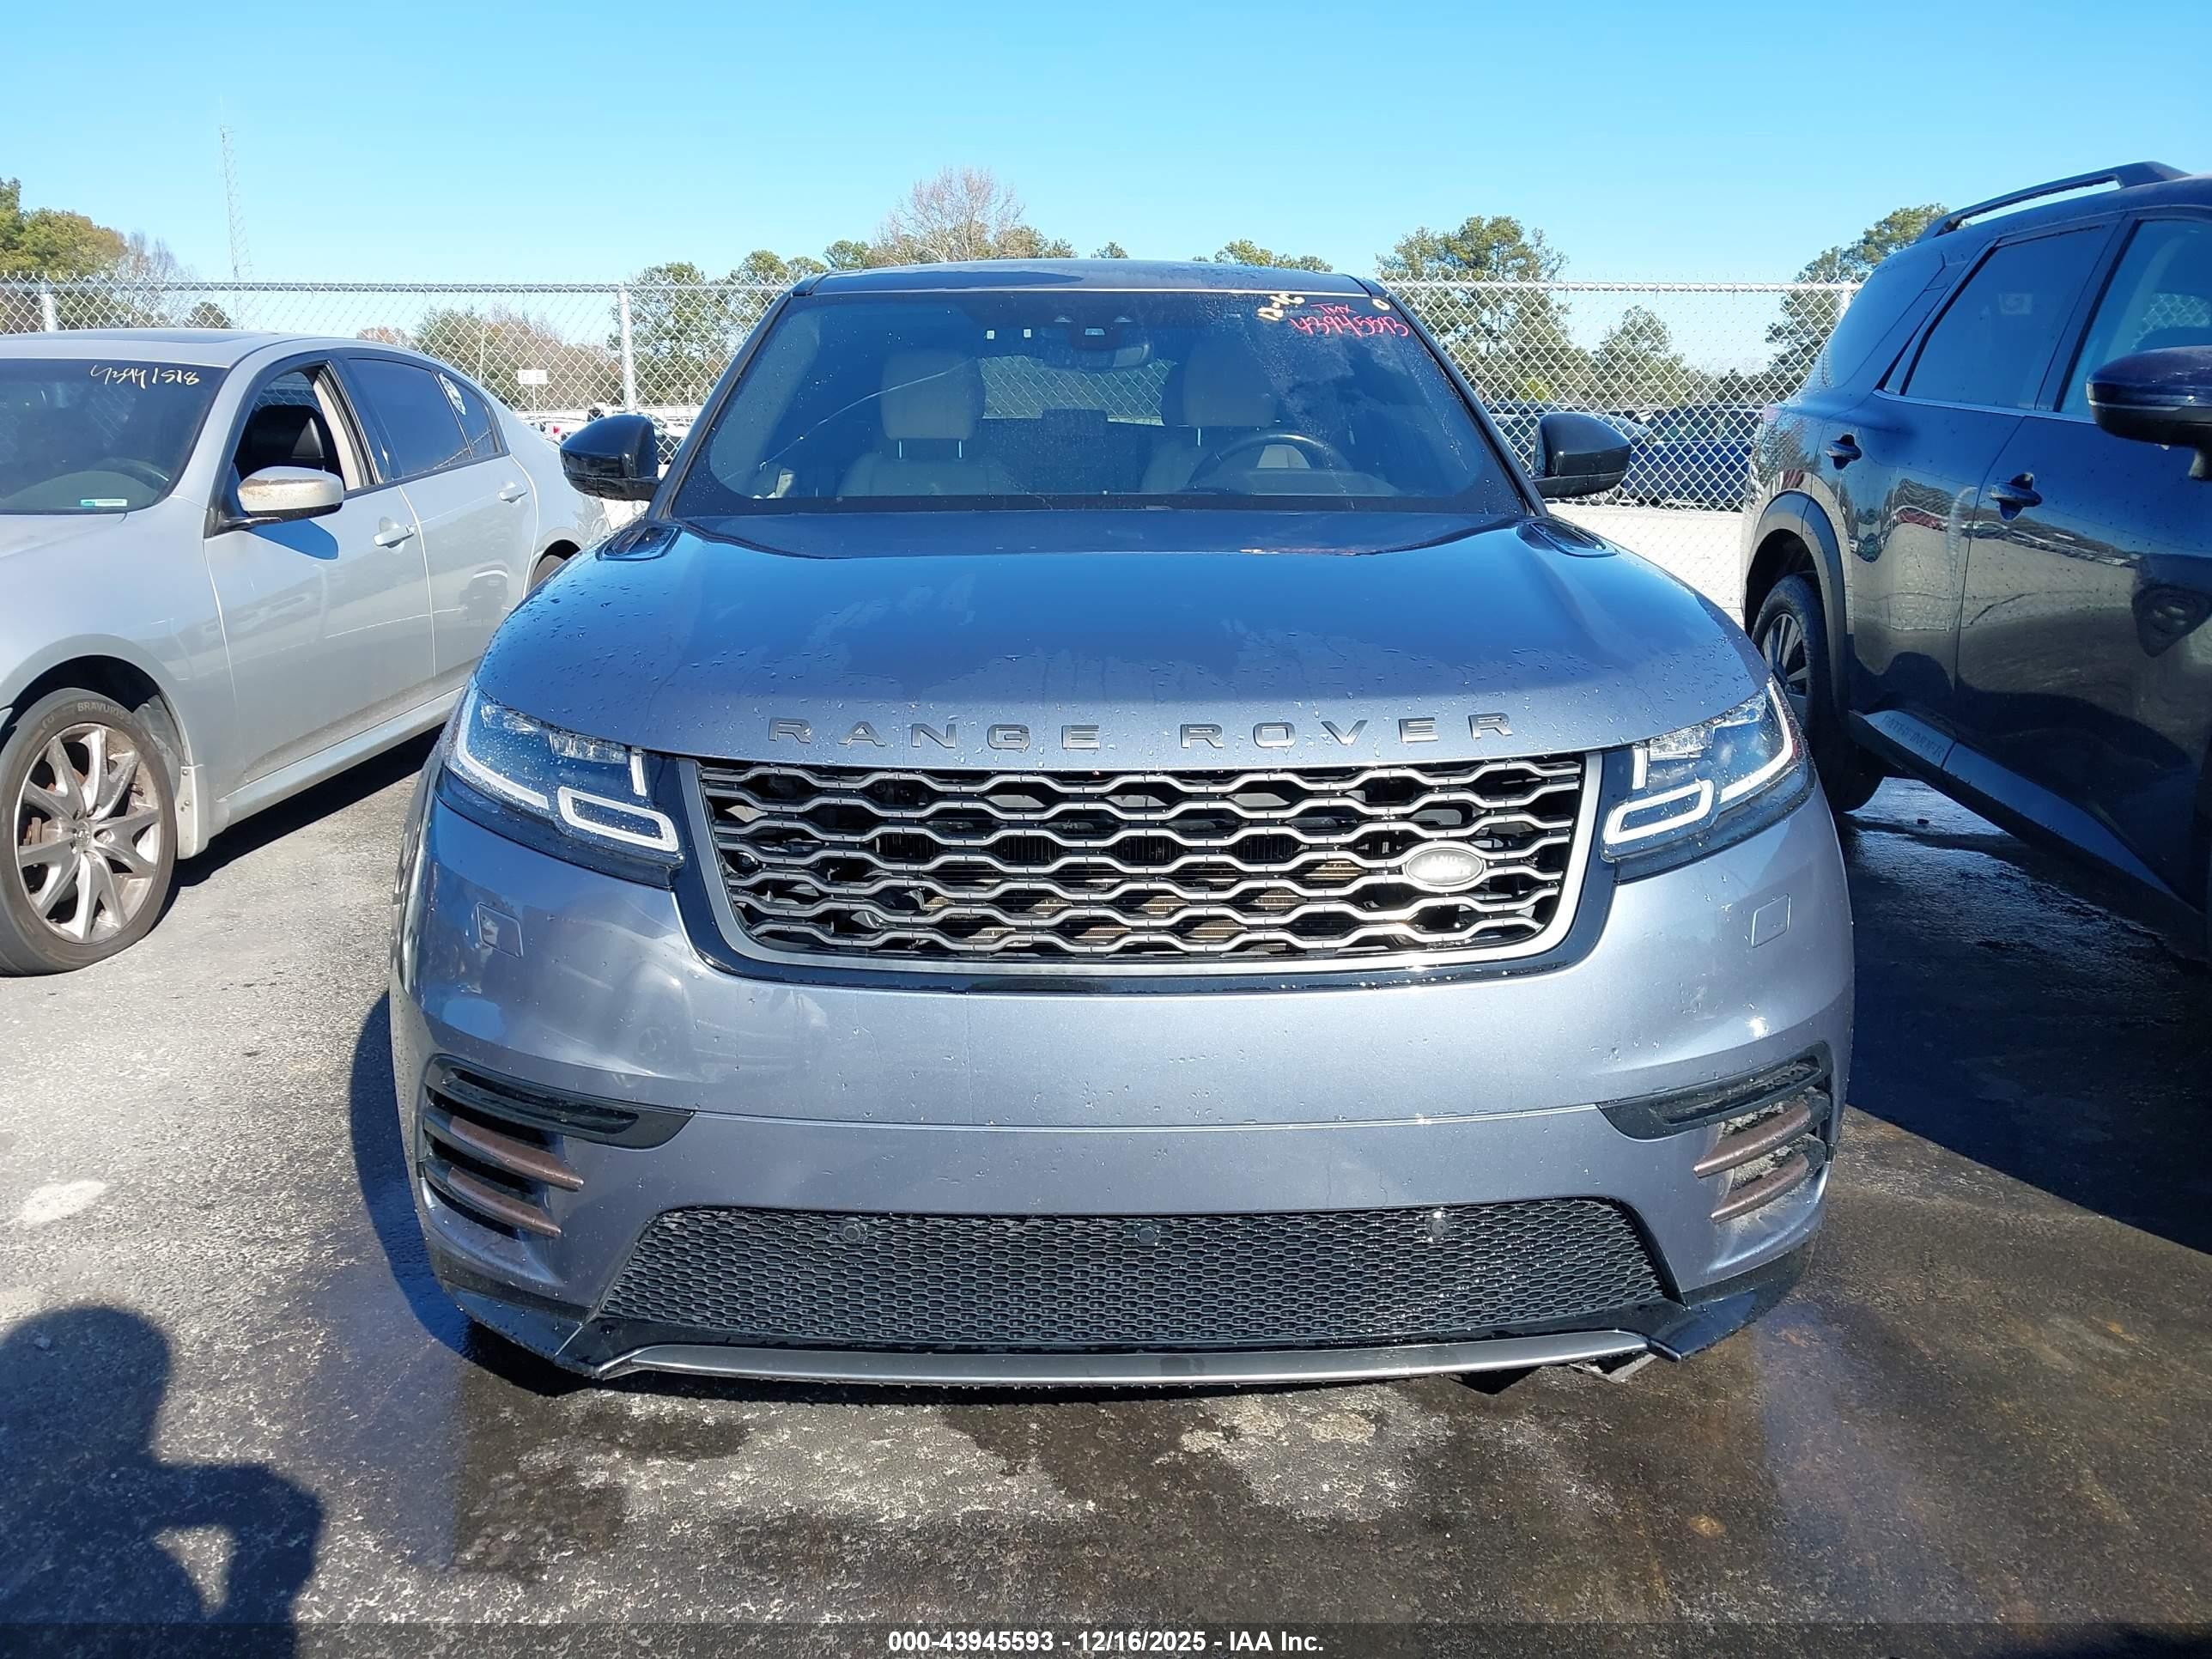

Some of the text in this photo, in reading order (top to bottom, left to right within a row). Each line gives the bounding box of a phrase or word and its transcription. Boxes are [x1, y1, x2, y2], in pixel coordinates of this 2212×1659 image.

[1289, 314, 1409, 337] 43945593
[76, 701, 125, 720] BRAVURIS
[769, 712, 1514, 750] RANGE ROVER
